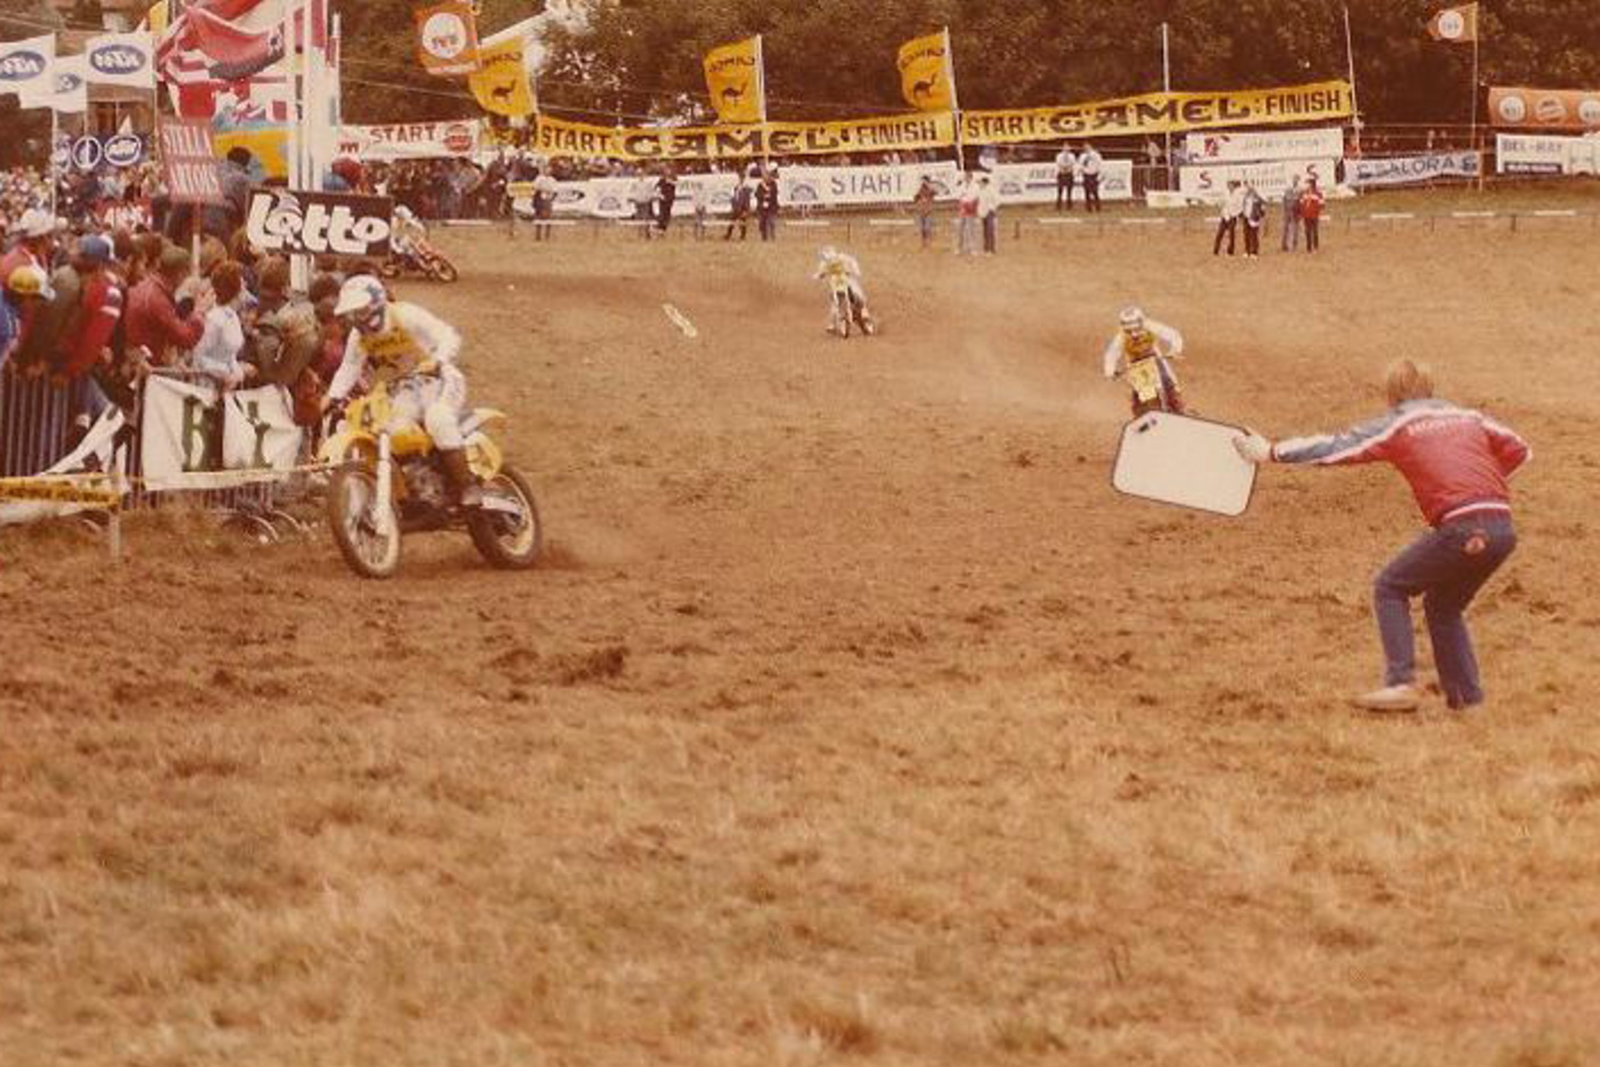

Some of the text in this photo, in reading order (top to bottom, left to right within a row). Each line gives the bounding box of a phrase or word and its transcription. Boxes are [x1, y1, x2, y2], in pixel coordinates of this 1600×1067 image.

[970, 90, 1342, 138] START CAMEL FINISH
[370, 124, 436, 144] START
[544, 121, 936, 156] START CAMEL FINISH
[831, 173, 902, 196] START
